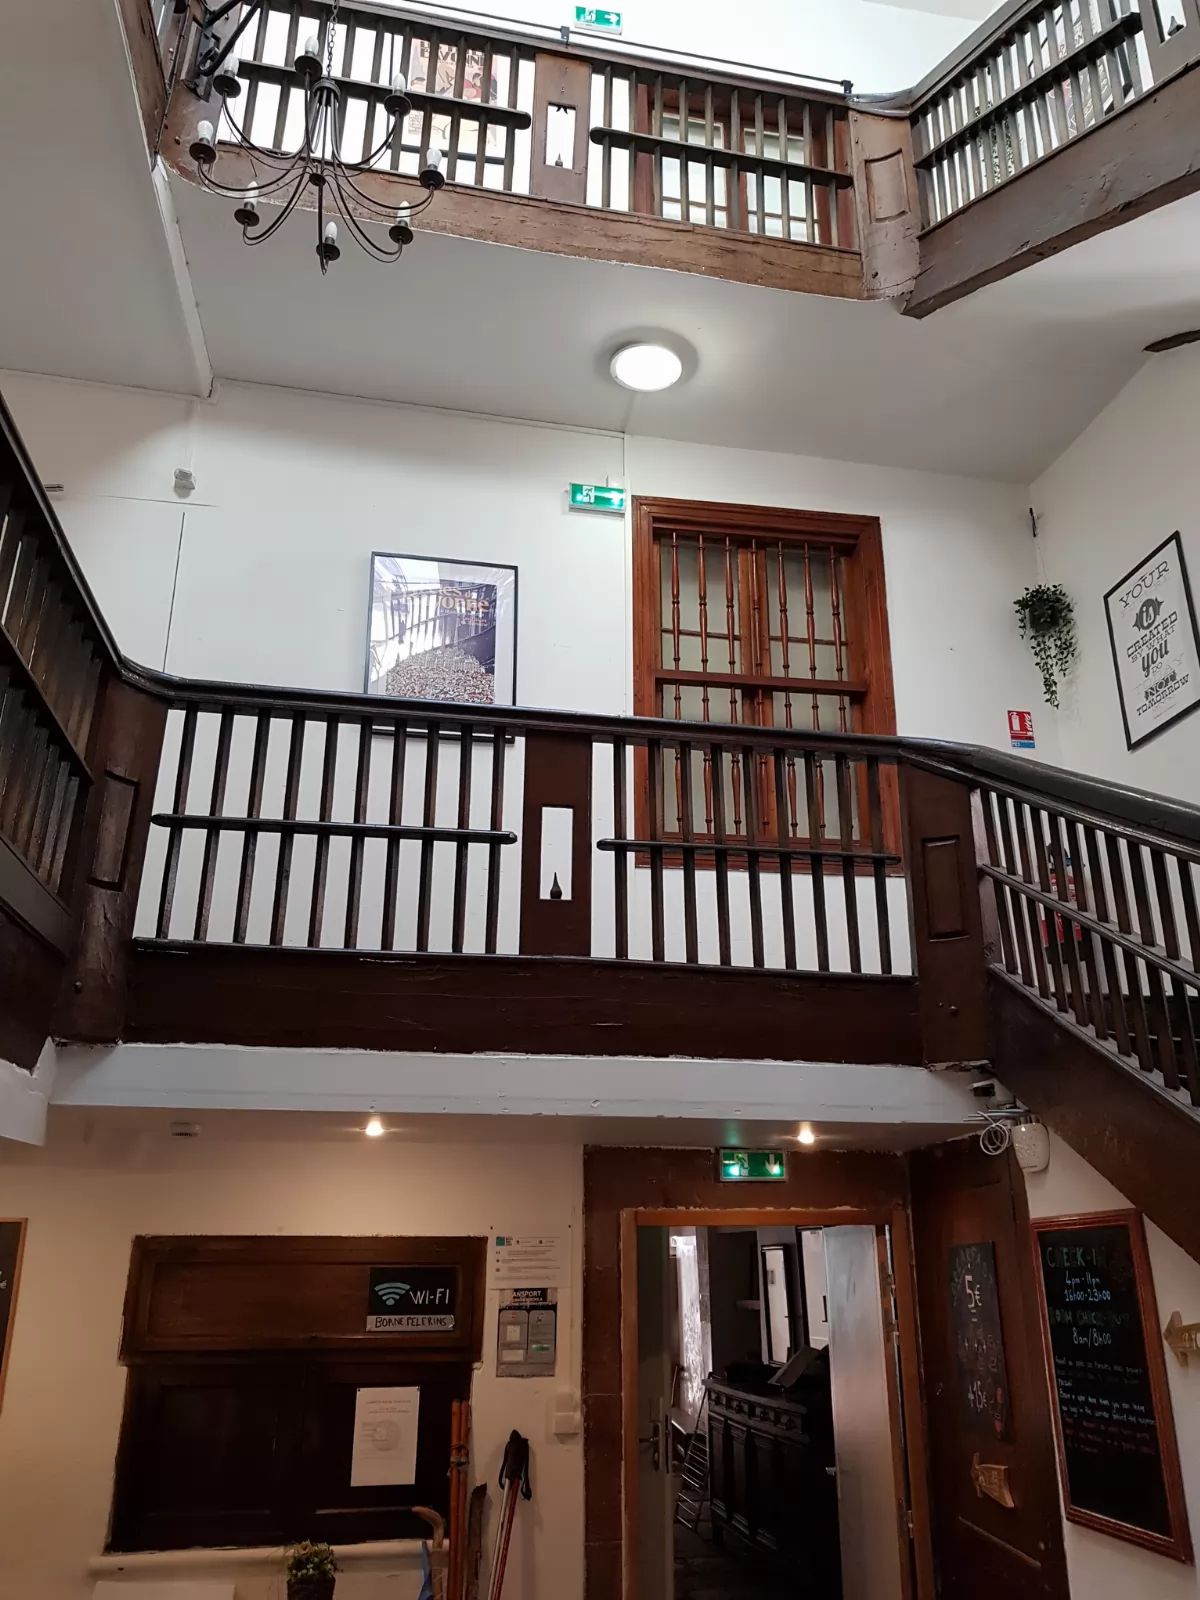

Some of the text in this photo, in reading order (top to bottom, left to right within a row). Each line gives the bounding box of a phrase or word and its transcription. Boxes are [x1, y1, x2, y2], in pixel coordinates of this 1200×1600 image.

[1118, 560, 1170, 609] YOUR
[1126, 611, 1178, 658] CREATED
[1143, 605, 1155, 628] is
[1131, 625, 1176, 663] BY WHAT
[1141, 639, 1169, 678] you
[1132, 652, 1185, 696] TODAY
[1146, 674, 1175, 698] NOT
[1151, 661, 1163, 674] DO
[1136, 673, 1190, 716] TOMORROW
[409, 1288, 449, 1305] WI-FI
[375, 1316, 404, 1328] BORNE
